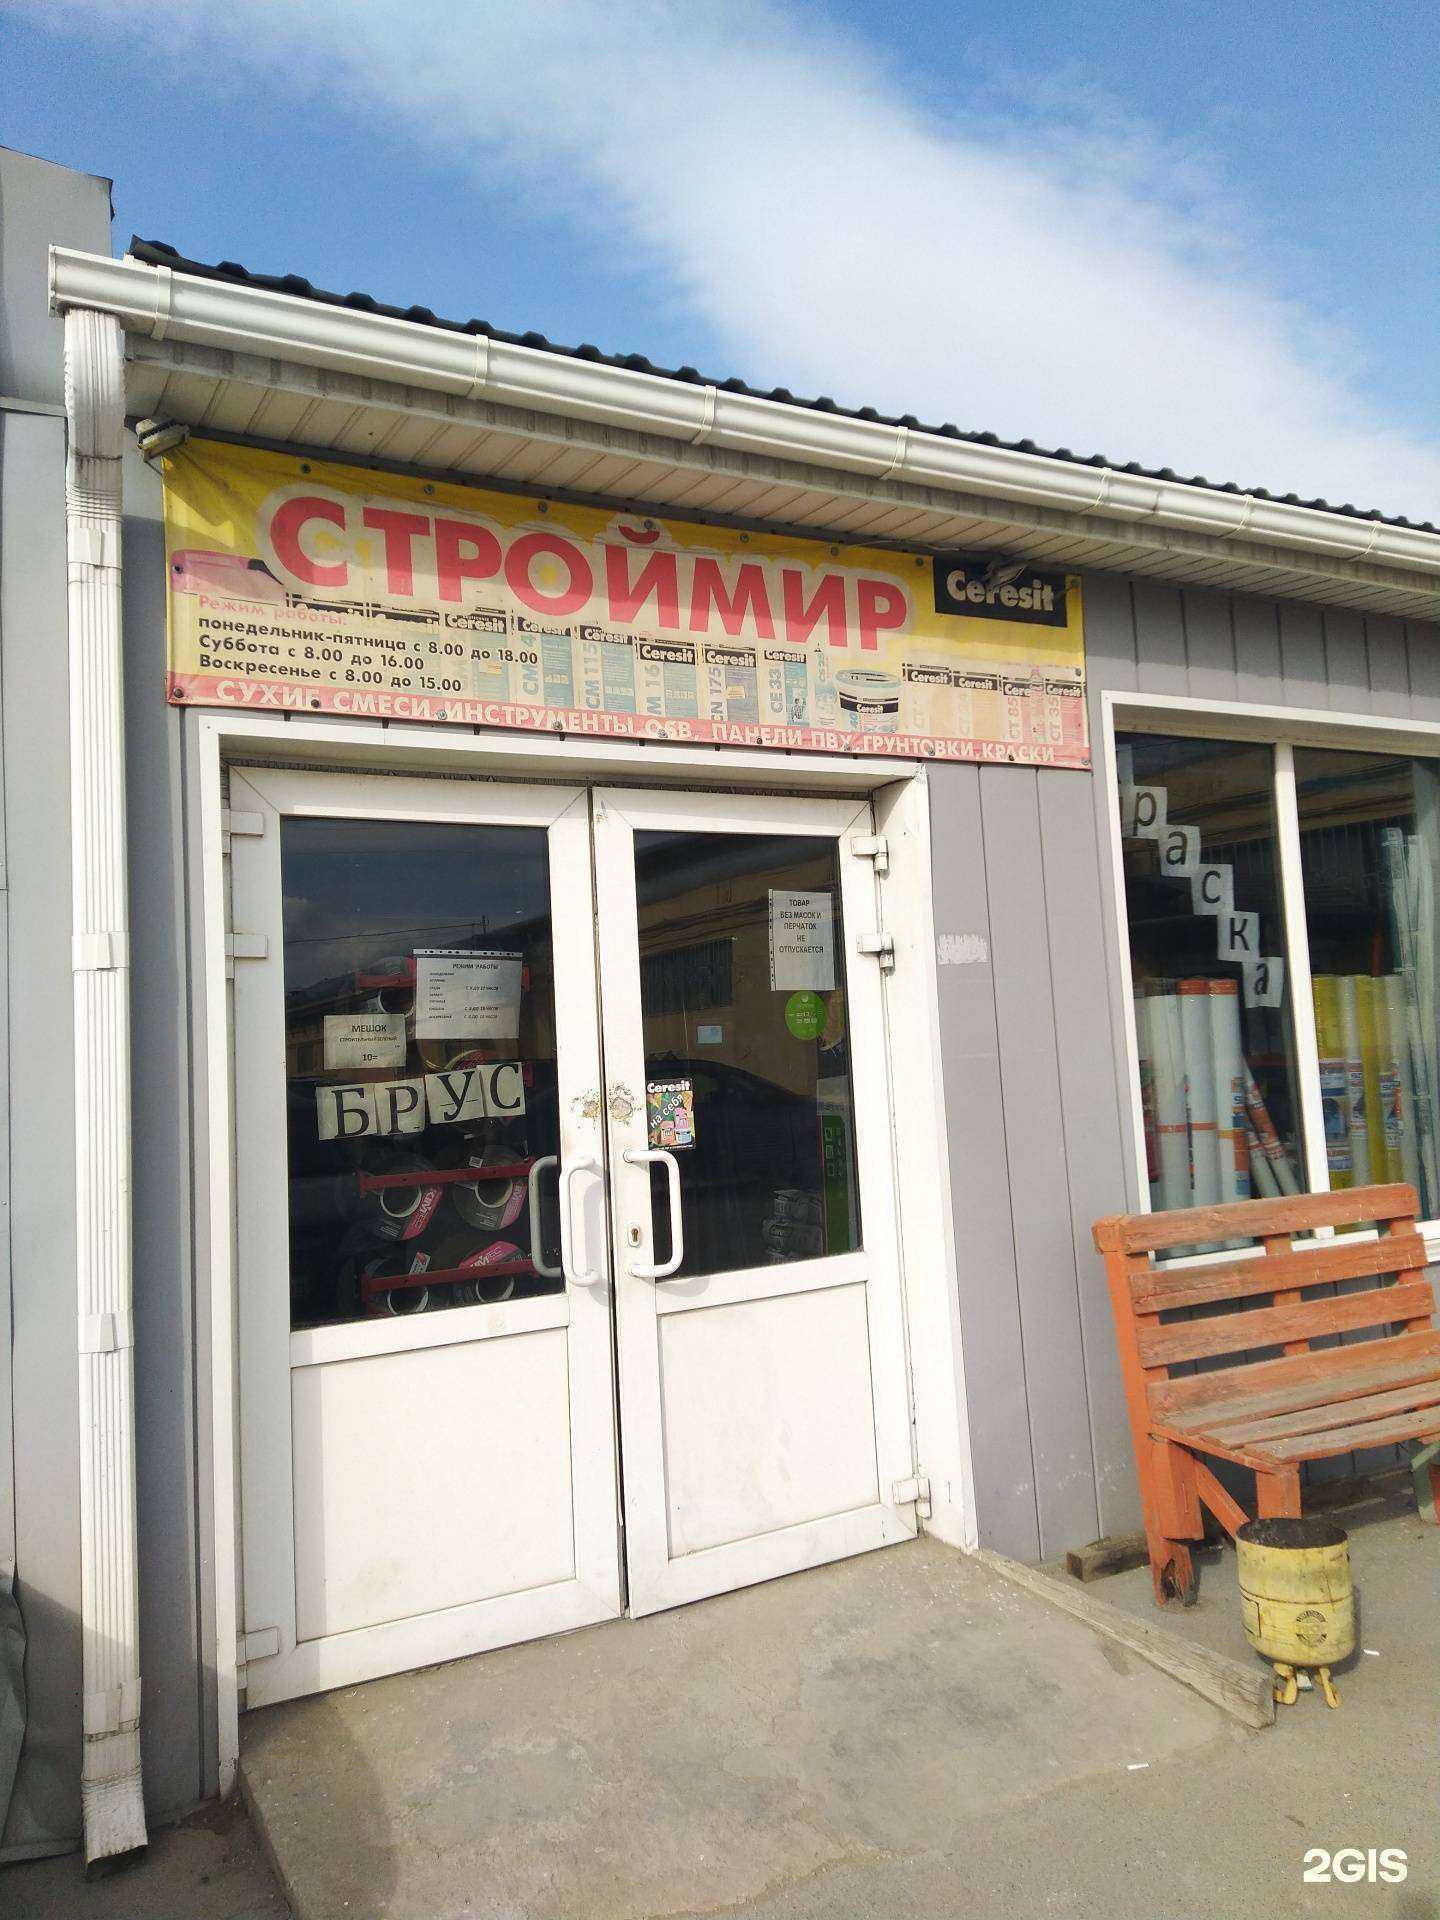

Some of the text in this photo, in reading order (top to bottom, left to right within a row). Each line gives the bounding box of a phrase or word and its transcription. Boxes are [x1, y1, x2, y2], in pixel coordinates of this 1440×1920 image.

[270, 496, 909, 651] СТРОЙМИР
[946, 569, 1055, 612] Ceresit
[199, 595, 265, 616] Режим
[446, 614, 505, 633] Ceresit
[198, 617, 406, 652] понедельник-пятница
[413, 640, 421, 652] с
[428, 641, 464, 657] 8.00
[470, 648, 490, 660] до
[499, 648, 538, 665] 18.00
[584, 627, 629, 645] Ceresit
[199, 634, 425, 670] Суббота с 8.00 до 16.00
[641, 646, 694, 663] Ceresit
[706, 651, 755, 667] Ceresit
[766, 650, 805, 663] Ceresit
[199, 653, 462, 692] Воскресенье с 8.00 до 15.00
[910, 671, 949, 684] Ceresit
[958, 679, 993, 690] Ceresit
[1004, 682, 1032, 697] Cere
[1046, 684, 1082, 698] Ceresit
[856, 703, 884, 715] Ceresit
[216, 680, 321, 709] СУХИЕ
[711, 722, 801, 747] ПАНЕЛИ
[983, 744, 1056, 762] КРАСКИ
[788, 899, 810, 907] ТОВАР
[780, 911, 793, 919] БЕЗ
[794, 911, 816, 919] МАСОК
[783, 922, 817, 930] ПЕРЧАТОК
[796, 934, 806, 942] НЕ
[778, 945, 824, 954] ОТПУСКАЕТСЯ
[351, 1024, 387, 1033] МЕШОК
[647, 1080, 691, 1094] Ceresit
[330, 1063, 521, 1139] БРУС
[650, 1094, 684, 1128] на себя
